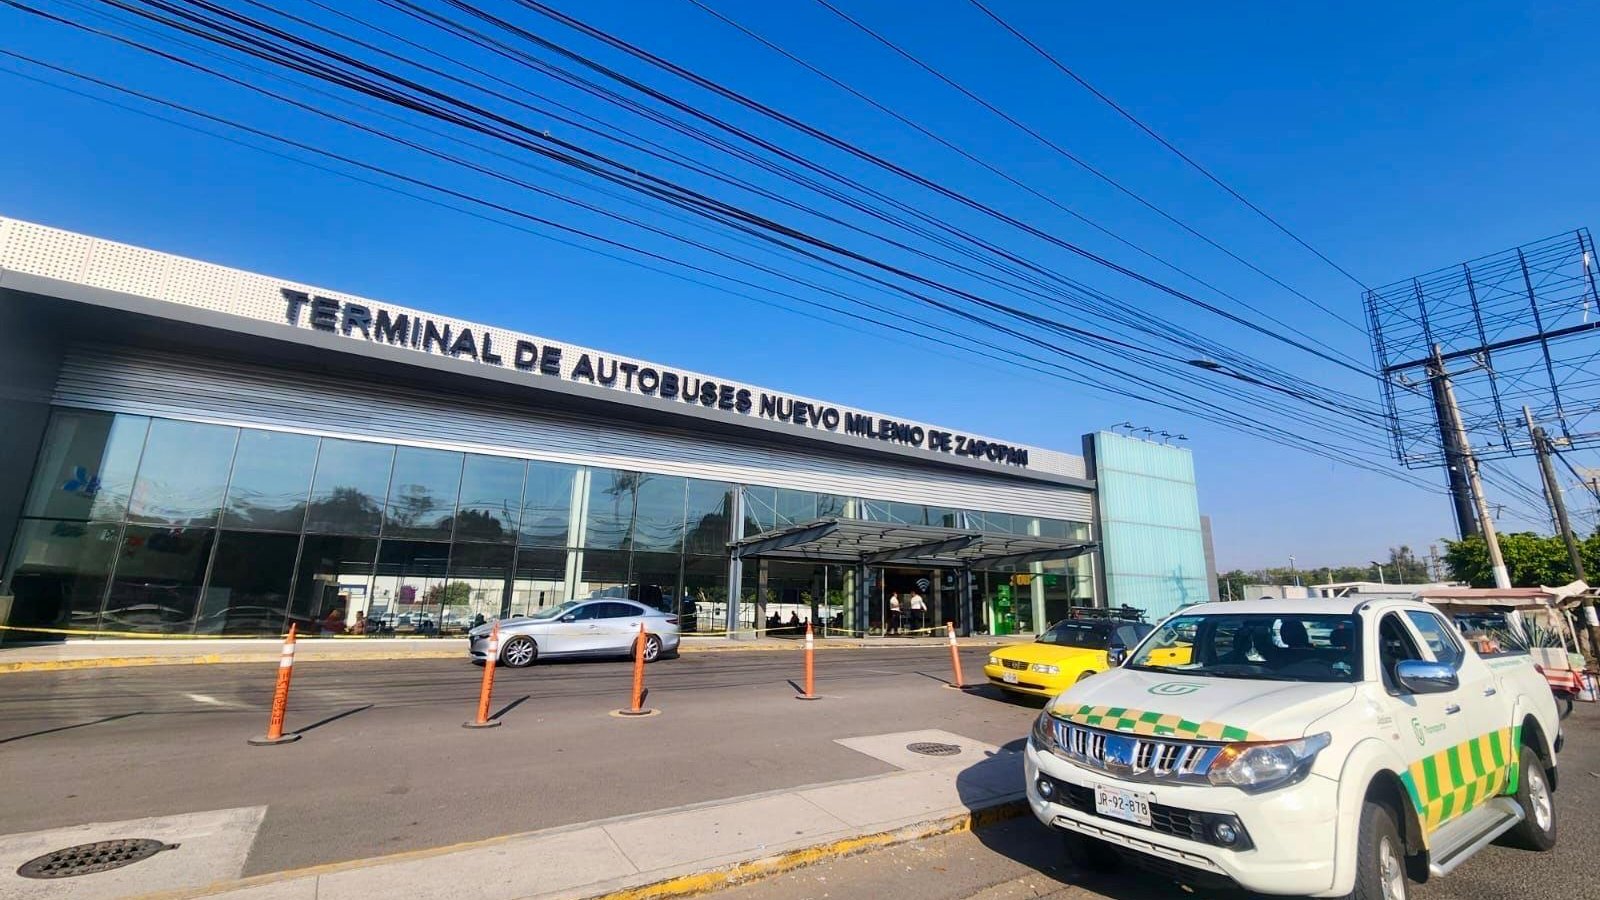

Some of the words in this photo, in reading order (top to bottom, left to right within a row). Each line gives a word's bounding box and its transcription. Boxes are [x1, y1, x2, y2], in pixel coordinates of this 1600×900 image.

[280, 288, 503, 366] TERMINAL
[514, 339, 563, 376] DE
[571, 353, 752, 413] AUTOBUSES
[759, 393, 839, 430] NUEVO
[844, 411, 925, 447] MILENIO
[928, 429, 953, 453] DE
[955, 435, 1028, 467] ZAPOPAN
[1098, 793, 1147, 815] JR-92-878
